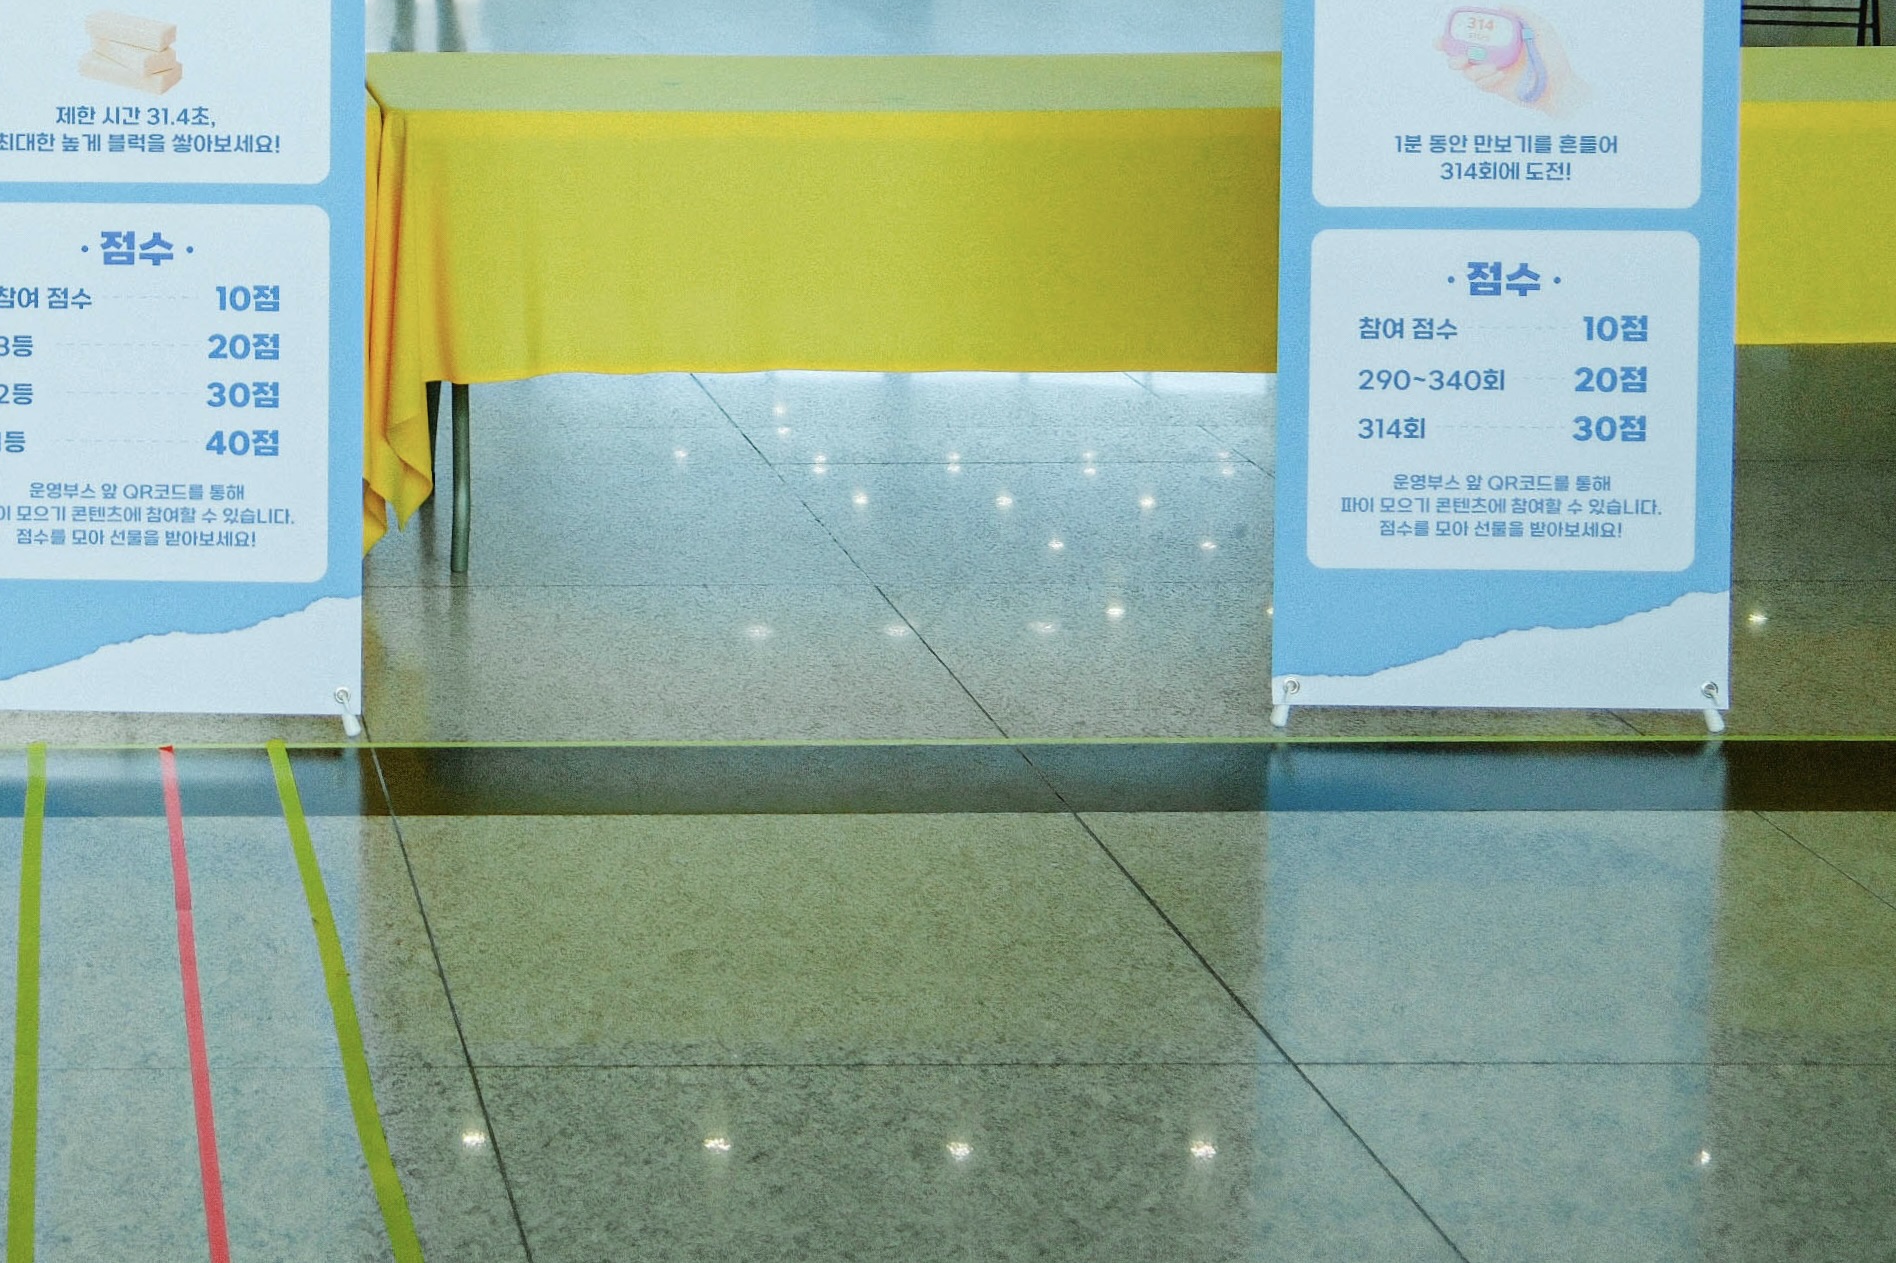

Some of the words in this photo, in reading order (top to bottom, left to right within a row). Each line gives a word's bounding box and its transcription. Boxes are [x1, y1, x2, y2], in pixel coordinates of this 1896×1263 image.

[1467, 17, 1494, 31] 314
[56, 106, 95, 125] 제한
[102, 107, 140, 125] 시간
[147, 106, 215, 127] 31.4초,
[62, 134, 101, 152] 높게
[108, 134, 165, 152] 블럭을
[172, 134, 279, 153] 쌓아보세요!
[1396, 135, 1422, 153] 1분
[1430, 135, 1467, 153] 동안
[1474, 135, 1552, 153] 만보기를
[1559, 135, 1617, 153] 흔들어
[1441, 161, 1519, 180] 314회에
[1526, 162, 1570, 180] 도전!
[101, 231, 173, 266] 점수
[1467, 262, 1540, 296] 점수
[48, 288, 92, 309] 점수
[216, 286, 279, 312] 10점
[1360, 317, 1404, 339] 참여
[1413, 318, 1457, 340] 점수
[1584, 315, 1647, 341] 10점
[208, 334, 279, 360] 20점
[1359, 369, 1504, 391] 290~340회
[1575, 367, 1647, 393] 20점
[207, 382, 279, 408] 30점
[1359, 417, 1425, 439] 314회
[1573, 416, 1646, 442] 30점
[206, 430, 279, 456] 40점
[30, 482, 95, 499] 운영부스
[123, 484, 203, 500] QR코드를
[210, 485, 244, 500] 통해
[1394, 474, 1460, 490] 운영부스
[1488, 475, 1569, 491] QR코드를
[1576, 476, 1610, 491] 통해
[17, 506, 66, 521] 모으기
[72, 506, 141, 522] 콘텐츠에
[147, 506, 196, 523] 참여할
[223, 508, 294, 524] 있습니다.
[1341, 497, 1374, 512] 파이
[1380, 498, 1429, 513] 모으기
[1436, 497, 1506, 513] 콘텐츠에
[1512, 498, 1561, 514] 참여할
[1589, 499, 1661, 515] 있습니다.
[17, 529, 65, 545] 점수를
[73, 530, 104, 545] 모아
[111, 530, 159, 546] 선물을
[165, 531, 255, 547] 받아보세요!
[1380, 520, 1429, 536] 점수를
[1436, 521, 1468, 536] 모아
[1474, 521, 1523, 537] 선물을
[1530, 522, 1622, 537] 받아보세요!
